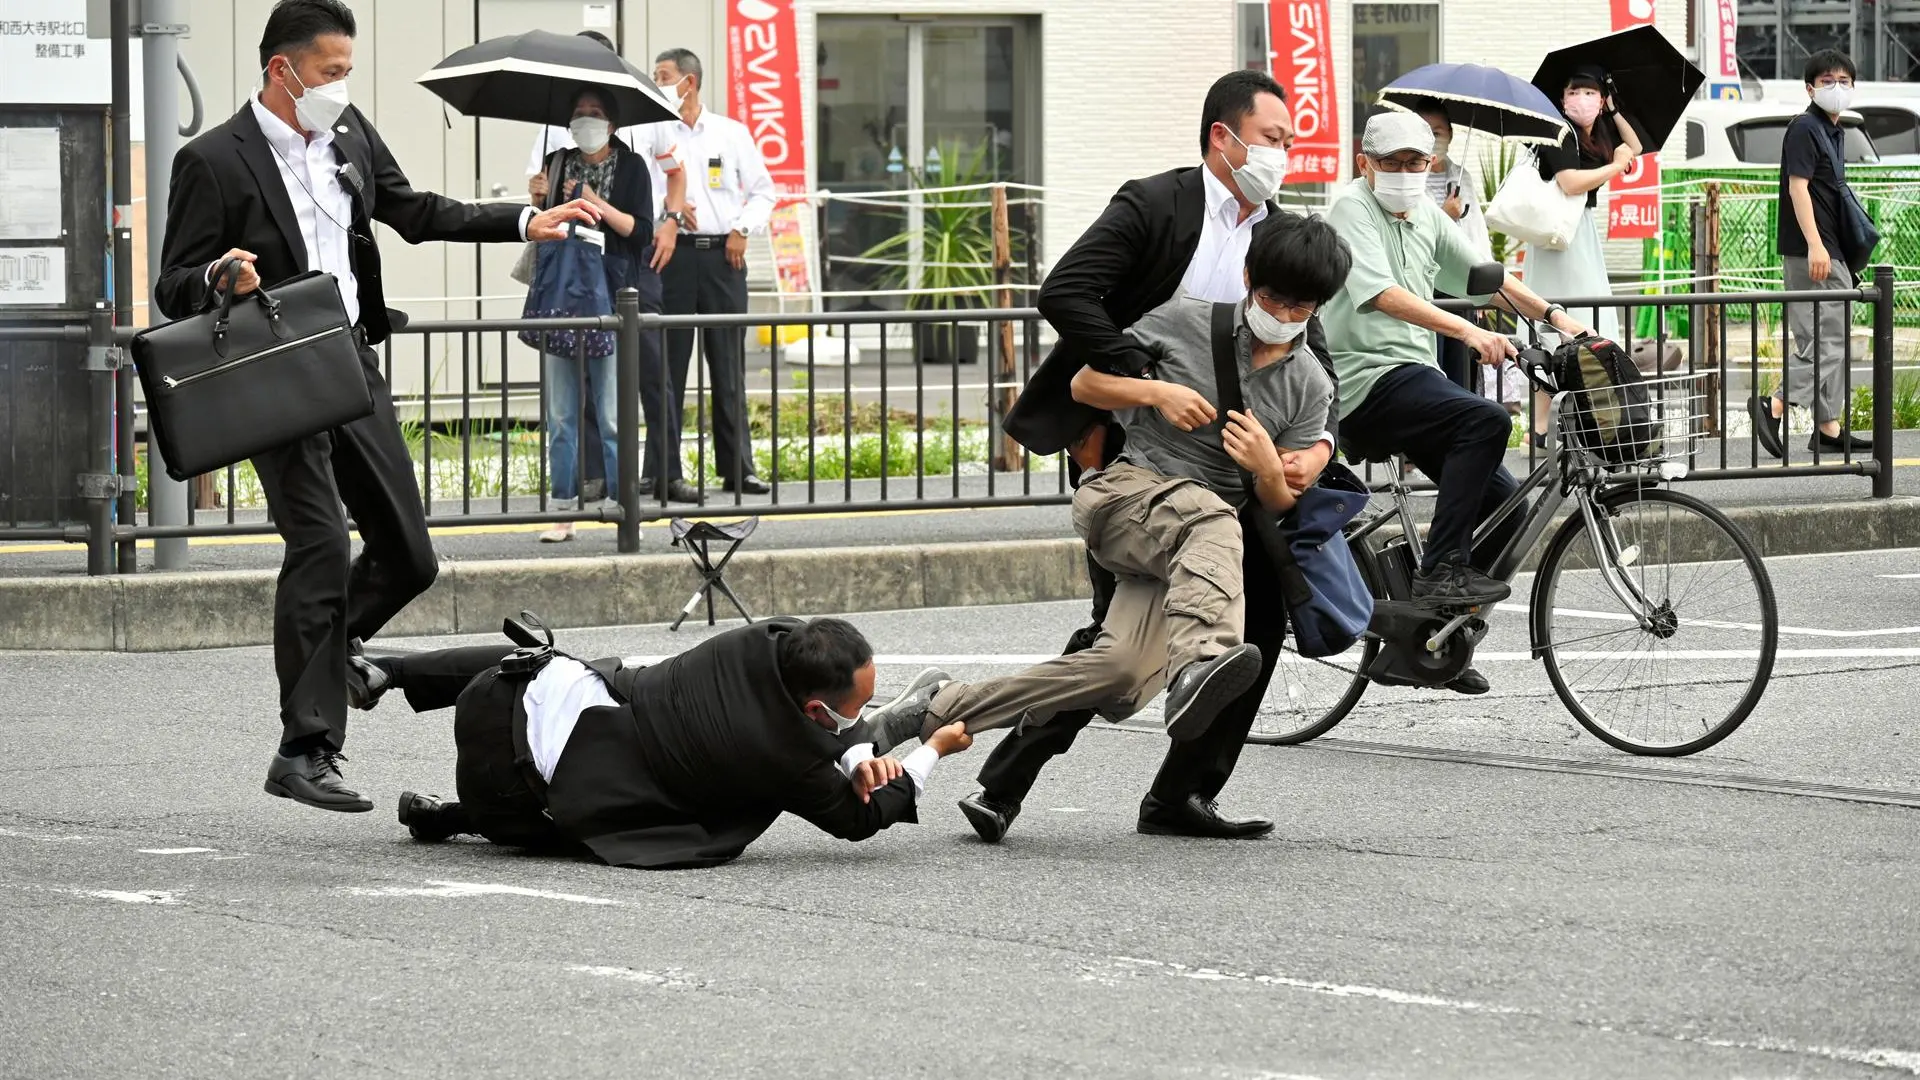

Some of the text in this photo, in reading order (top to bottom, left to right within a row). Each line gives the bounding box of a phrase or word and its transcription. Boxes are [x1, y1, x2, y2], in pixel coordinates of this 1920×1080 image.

[35, 43, 85, 58] 整備工事
[1289, 3, 1320, 138] SANKO
